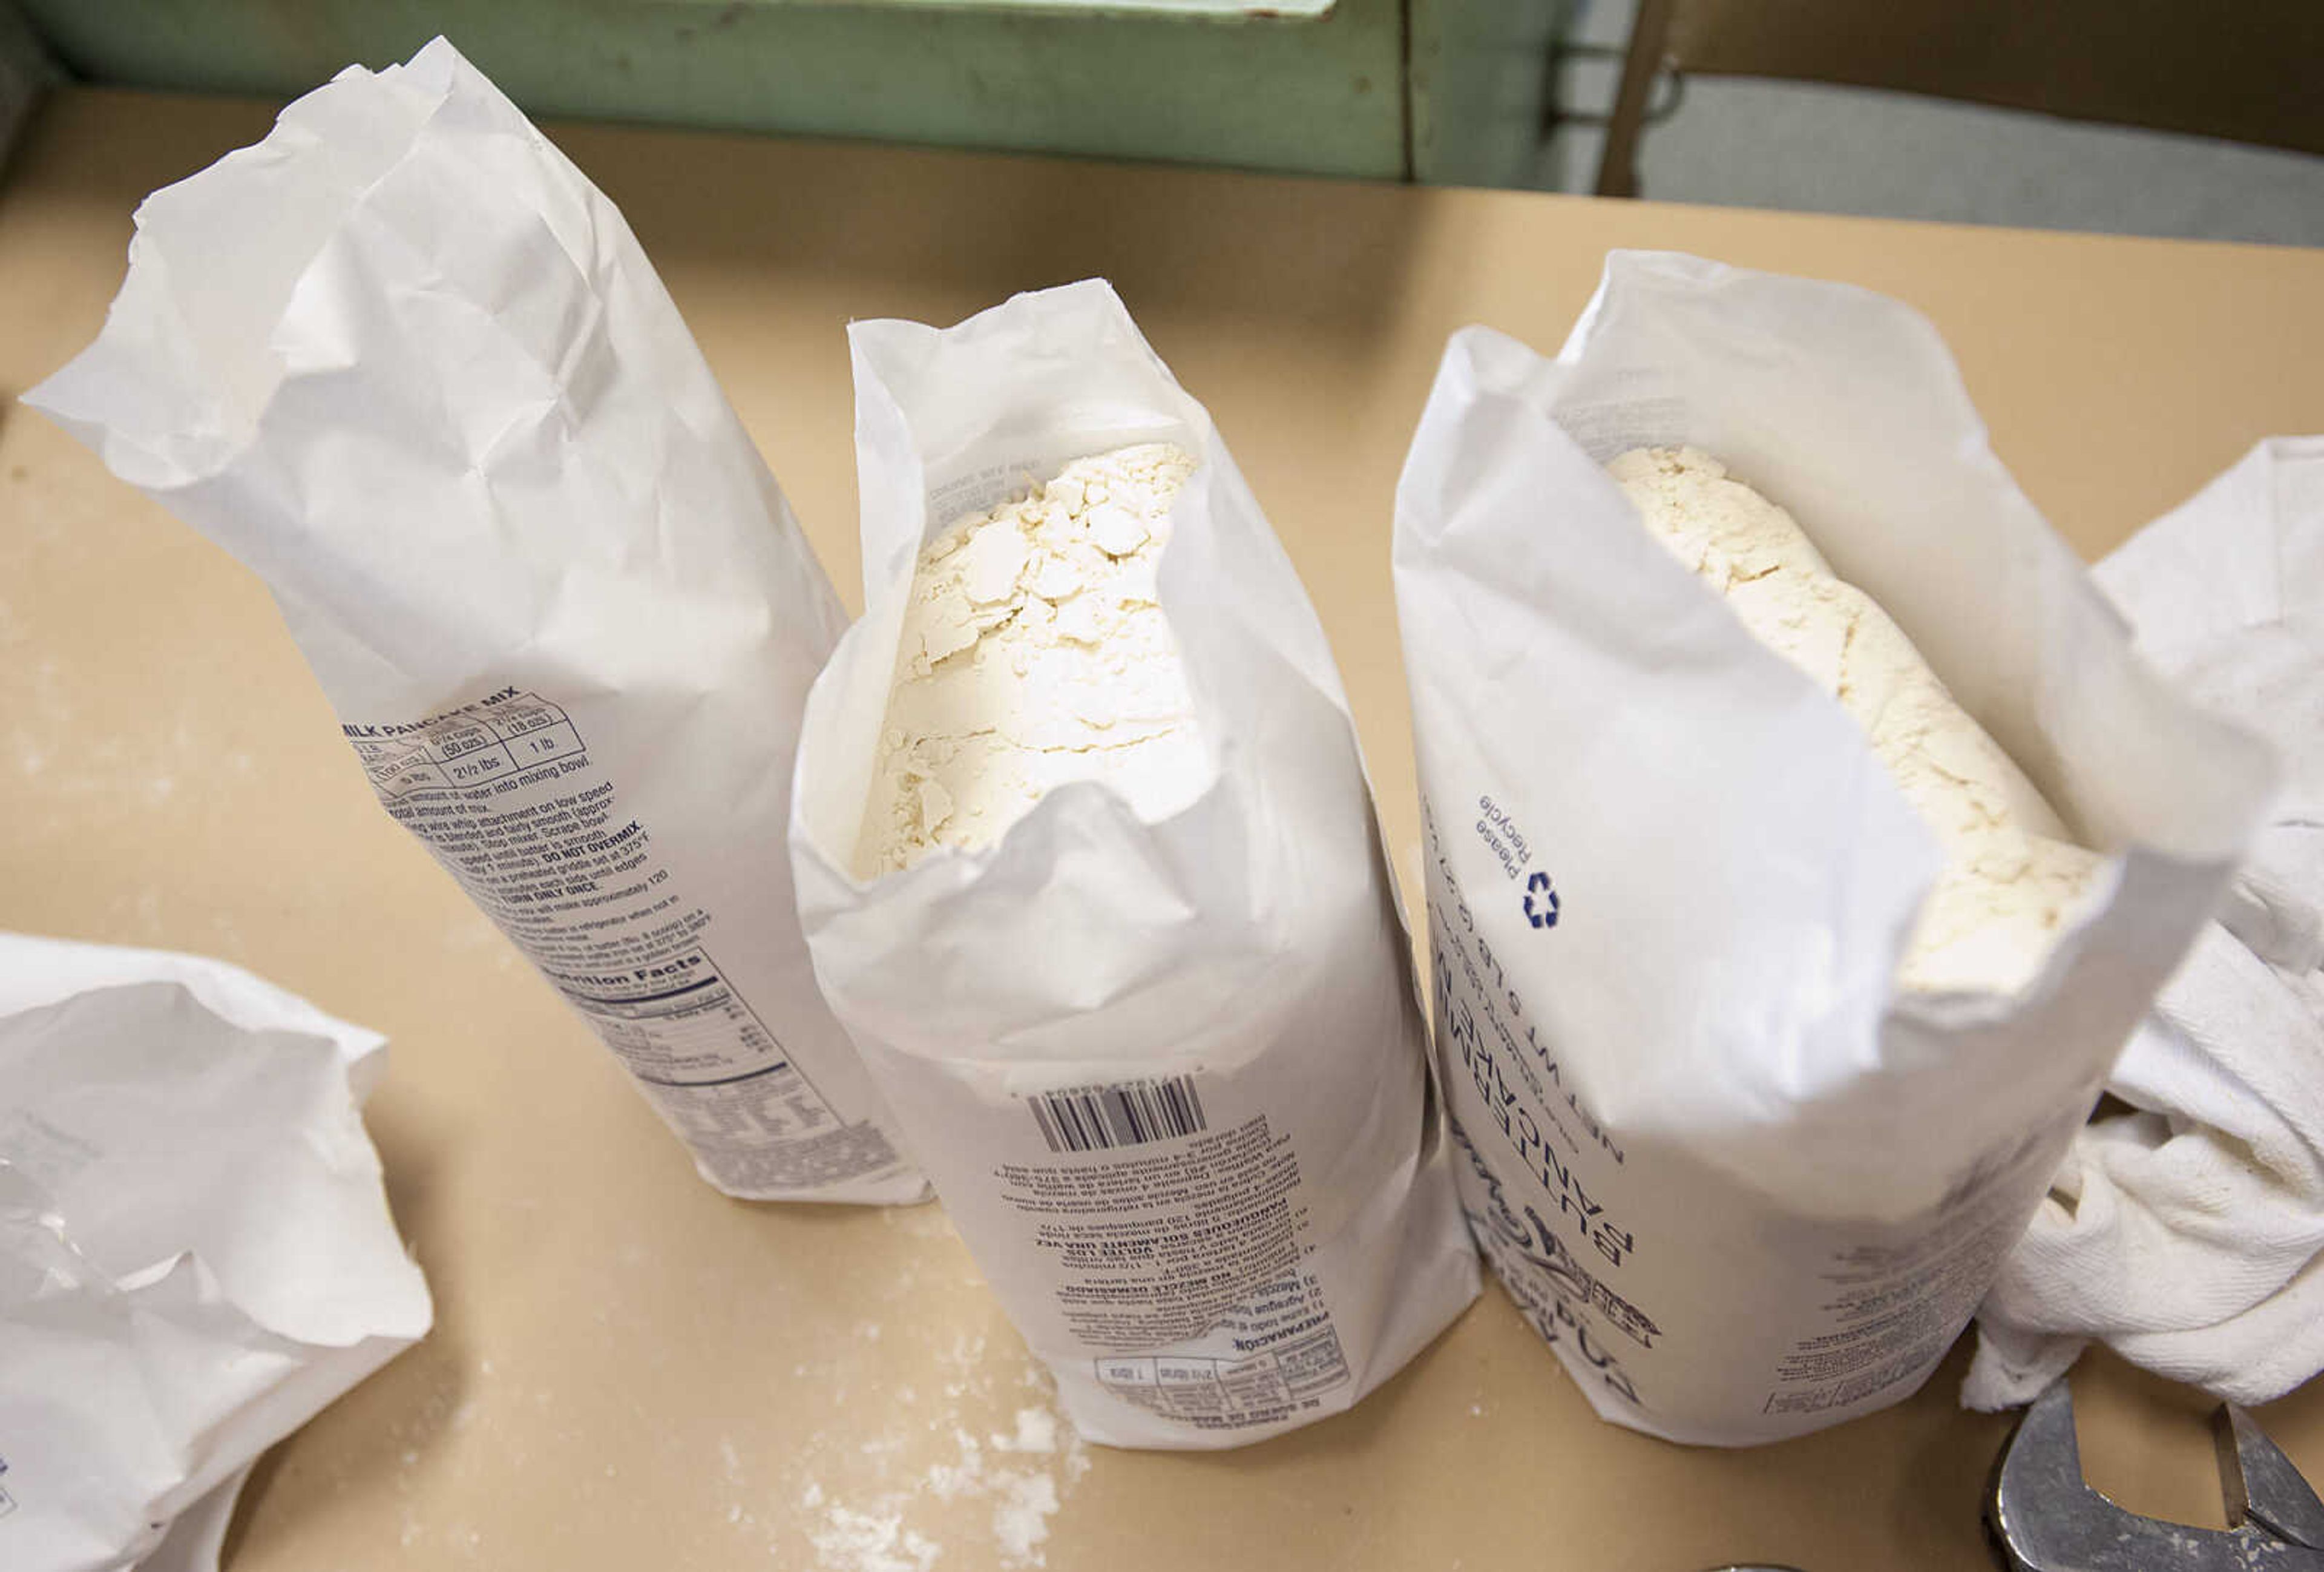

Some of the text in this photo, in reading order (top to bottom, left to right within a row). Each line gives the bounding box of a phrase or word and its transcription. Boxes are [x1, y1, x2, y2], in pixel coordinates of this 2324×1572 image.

[482, 686, 520, 706] MIX
[442, 743, 461, 758] (50
[508, 722, 527, 735] (18
[530, 742, 539, 753] 1
[493, 780, 517, 794] into
[519, 767, 560, 786] mixing
[478, 806, 538, 827] attachment
[539, 803, 555, 812] on
[555, 797, 577, 807] low
[579, 781, 613, 802] speed
[532, 812, 572, 827] smooth
[542, 823, 580, 837] Scrape
[563, 830, 606, 846] smooth
[1480, 796, 1531, 864] Recycle
[542, 852, 561, 862] DO
[562, 846, 585, 858] NOT
[1477, 821, 1520, 880] Please
[648, 870, 668, 884] 120
[534, 889, 563, 899] ONLY
[634, 956, 701, 980] Facts
[1478, 938, 1503, 988] LB
[1509, 990, 1521, 1016] 5
[1526, 1027, 1559, 1087] WT
[1461, 999, 1633, 1253] PANCAKE
[1566, 1093, 1623, 1165] NET
[1113, 1157, 1169, 1170] minutos
[1174, 1189, 1215, 1203] mezcla
[1167, 1215, 1190, 1224] 120
[1193, 1198, 1287, 1237] PANQUEQUES
[1104, 1234, 1188, 1248] SOLAMENTE
[1255, 1295, 1304, 1314] Agregue
